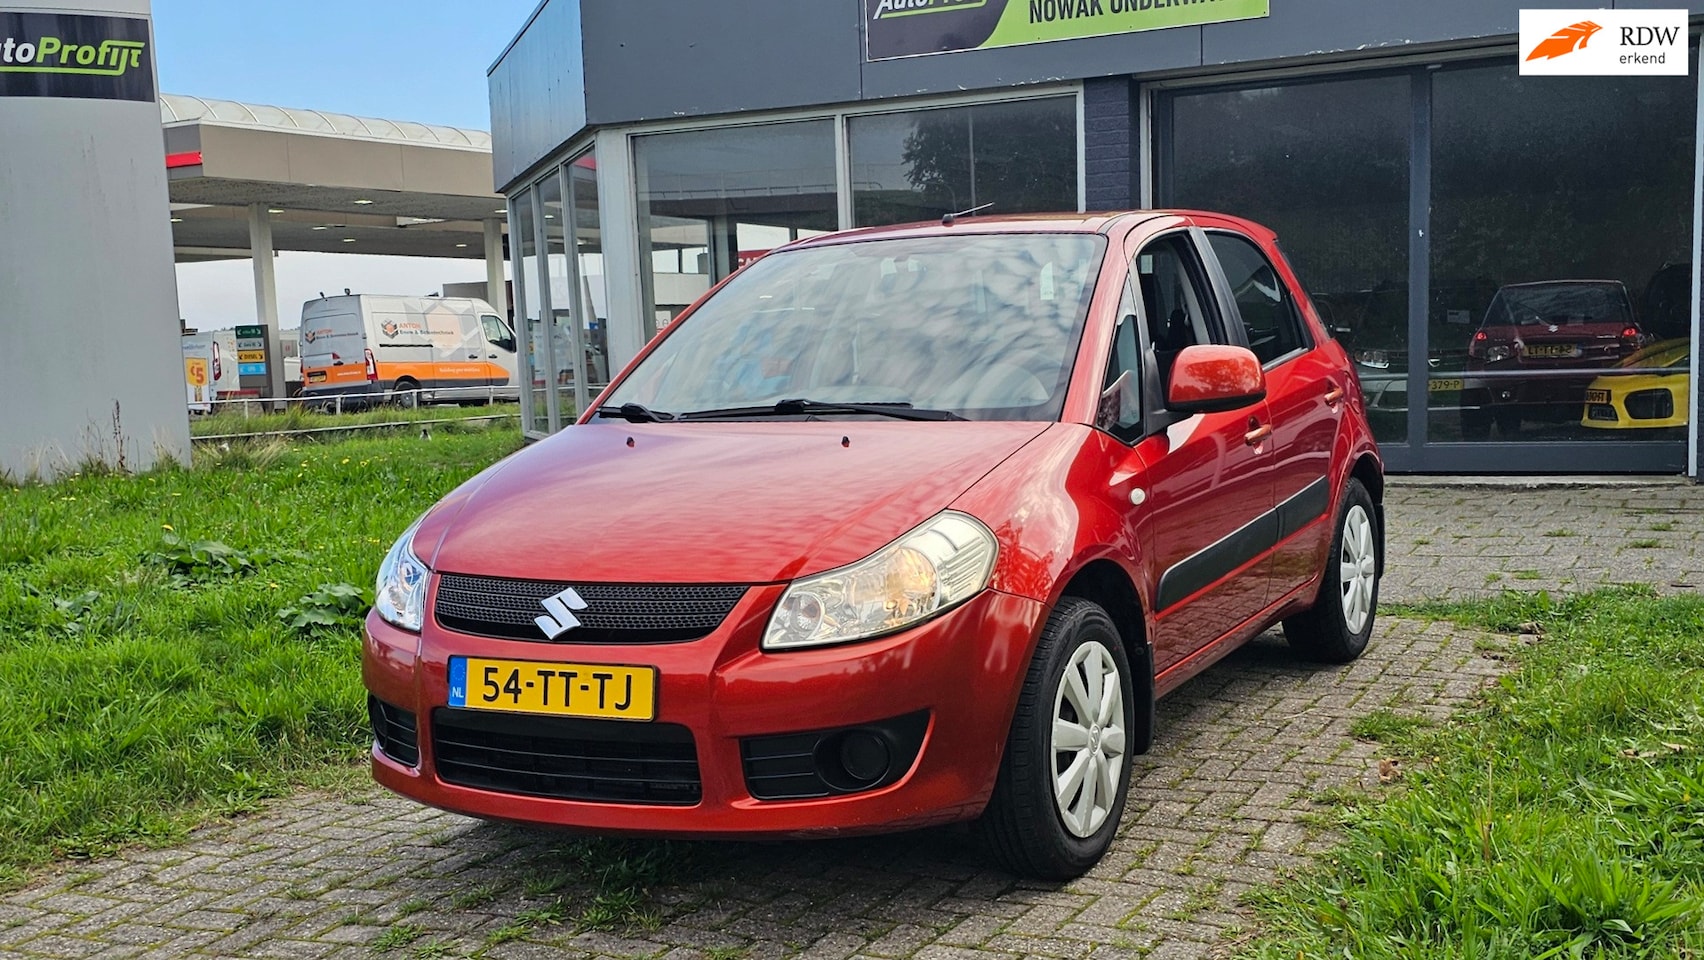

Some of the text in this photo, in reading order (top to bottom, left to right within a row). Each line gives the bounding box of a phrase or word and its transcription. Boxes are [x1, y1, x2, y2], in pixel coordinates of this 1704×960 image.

[1029, 0, 1104, 23] NOWAK
[0, 36, 145, 75] toProfijt
[1428, 380, 1460, 389] -379-P
[451, 688, 464, 699] NL
[482, 667, 632, 711] 54-TT-TJ
